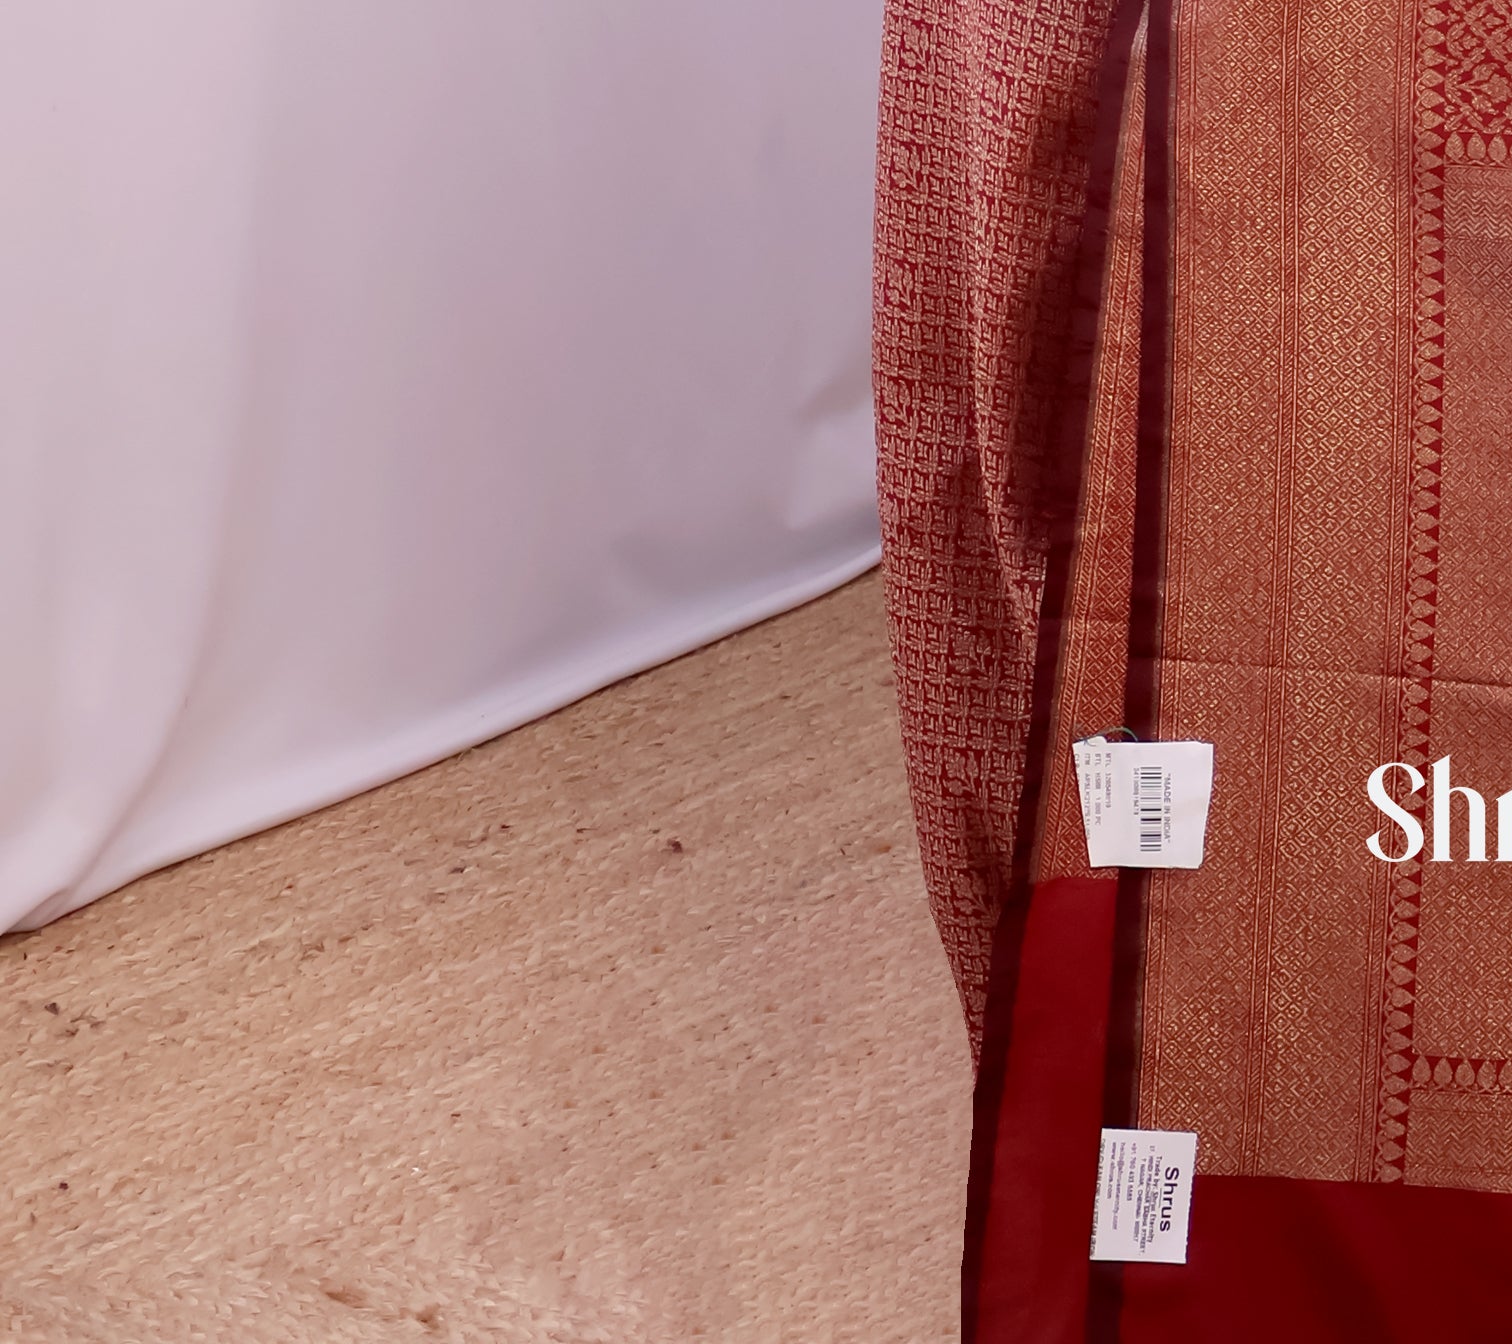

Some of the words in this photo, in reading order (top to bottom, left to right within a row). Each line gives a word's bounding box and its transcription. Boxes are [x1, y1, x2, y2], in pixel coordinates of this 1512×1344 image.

[1164, 806, 1171, 814] IN
[1154, 1156, 1162, 1176] Trade
[1159, 1166, 1180, 1233] Shrus
